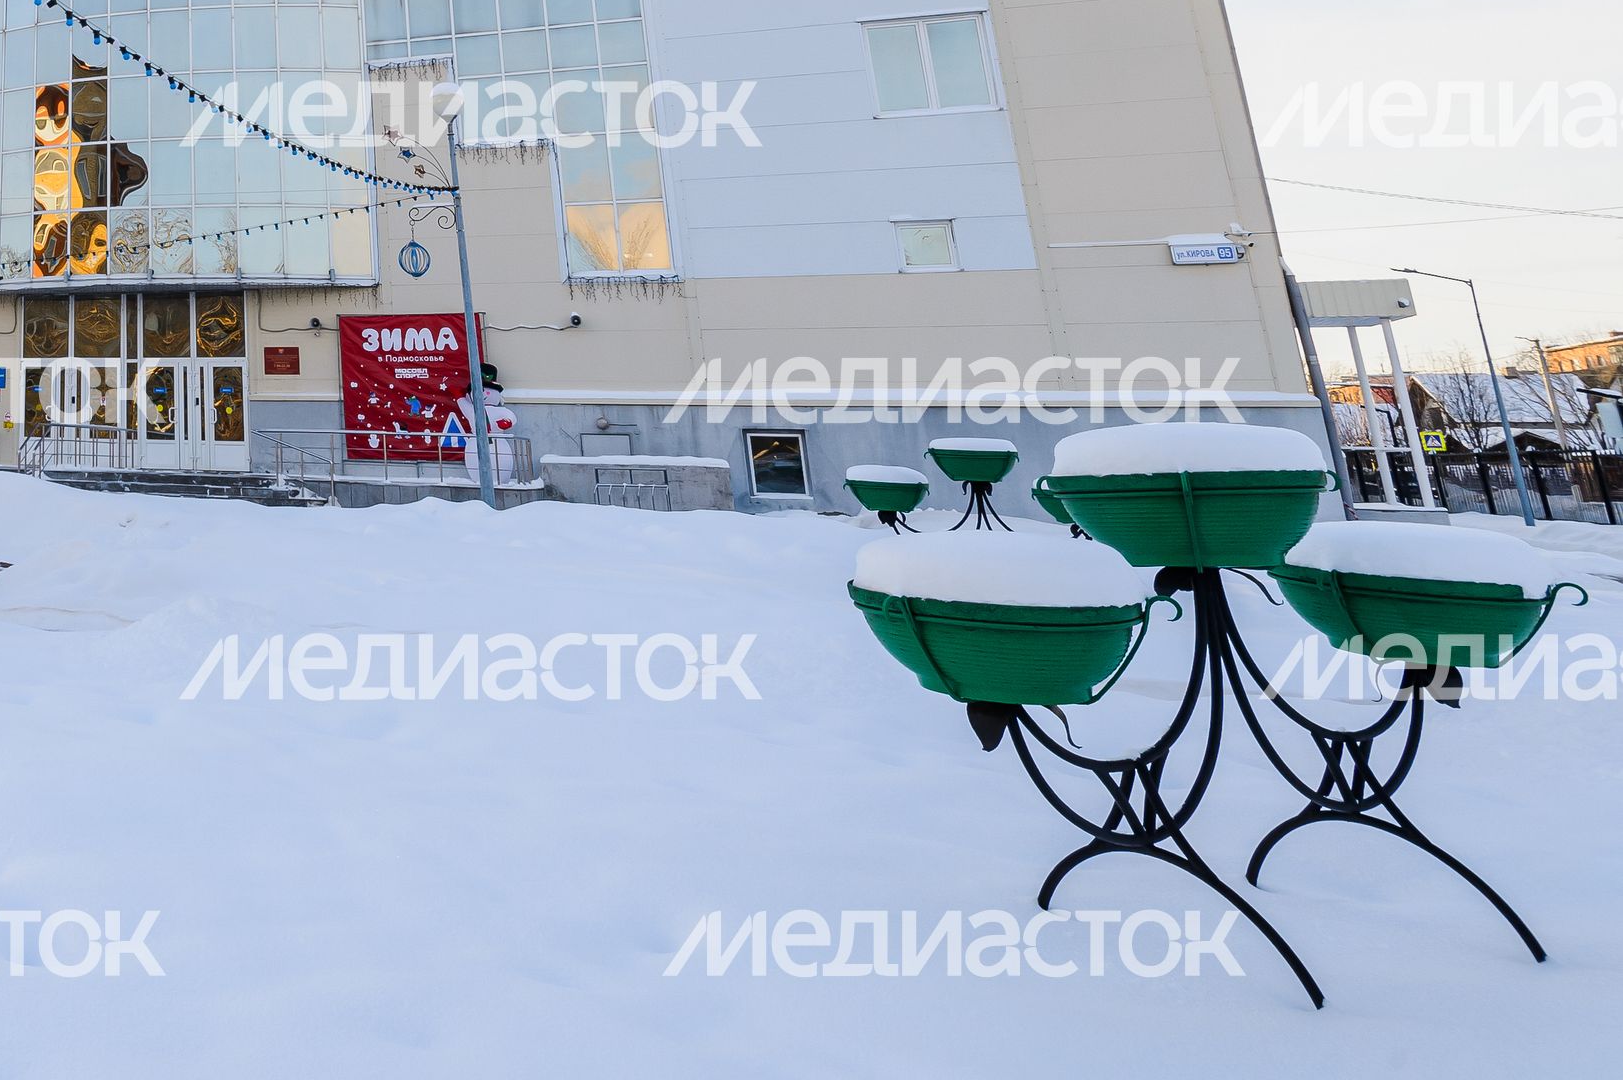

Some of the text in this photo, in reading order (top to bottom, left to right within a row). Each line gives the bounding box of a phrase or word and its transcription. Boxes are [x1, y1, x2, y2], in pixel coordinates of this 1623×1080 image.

[1219, 248, 1232, 258] 95
[361, 327, 459, 352] ЗИМА
[385, 354, 444, 363] Подмосковье
